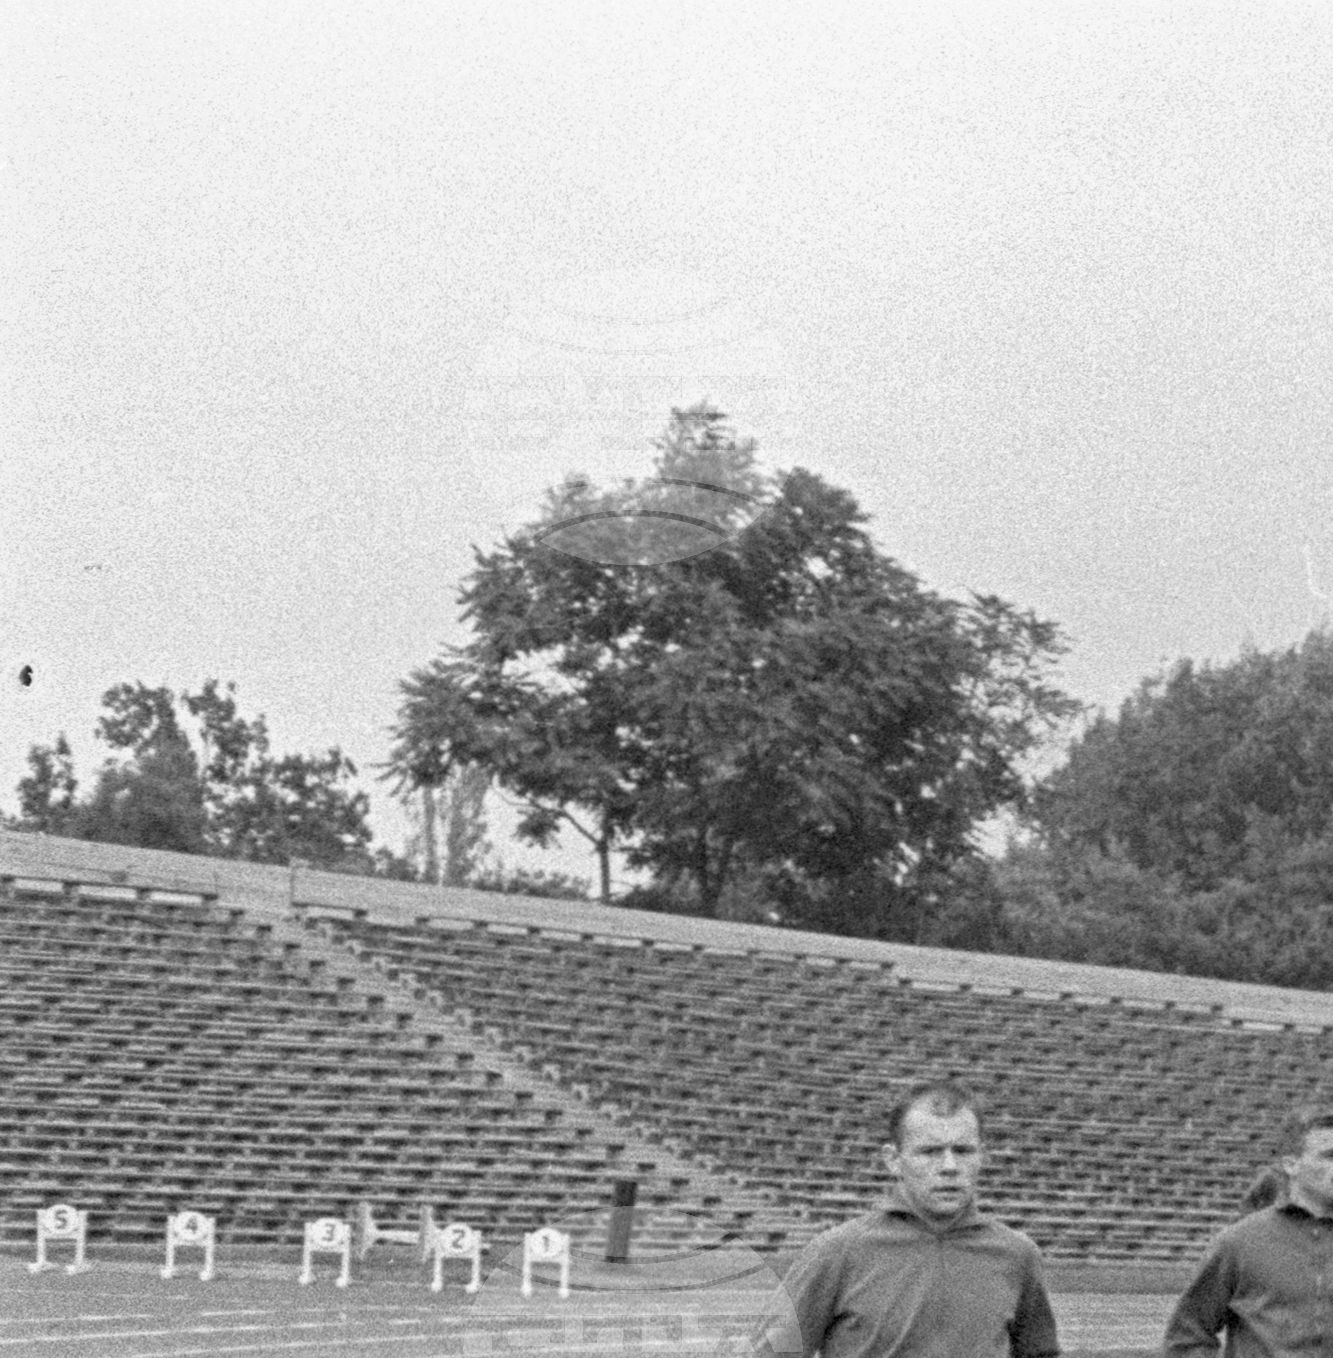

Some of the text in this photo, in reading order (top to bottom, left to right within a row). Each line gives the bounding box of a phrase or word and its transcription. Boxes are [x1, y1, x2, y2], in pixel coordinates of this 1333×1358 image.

[55, 1209, 68, 1229] 5
[186, 1215, 199, 1235] 4
[322, 1223, 336, 1242] 3
[452, 1229, 466, 1249] 2
